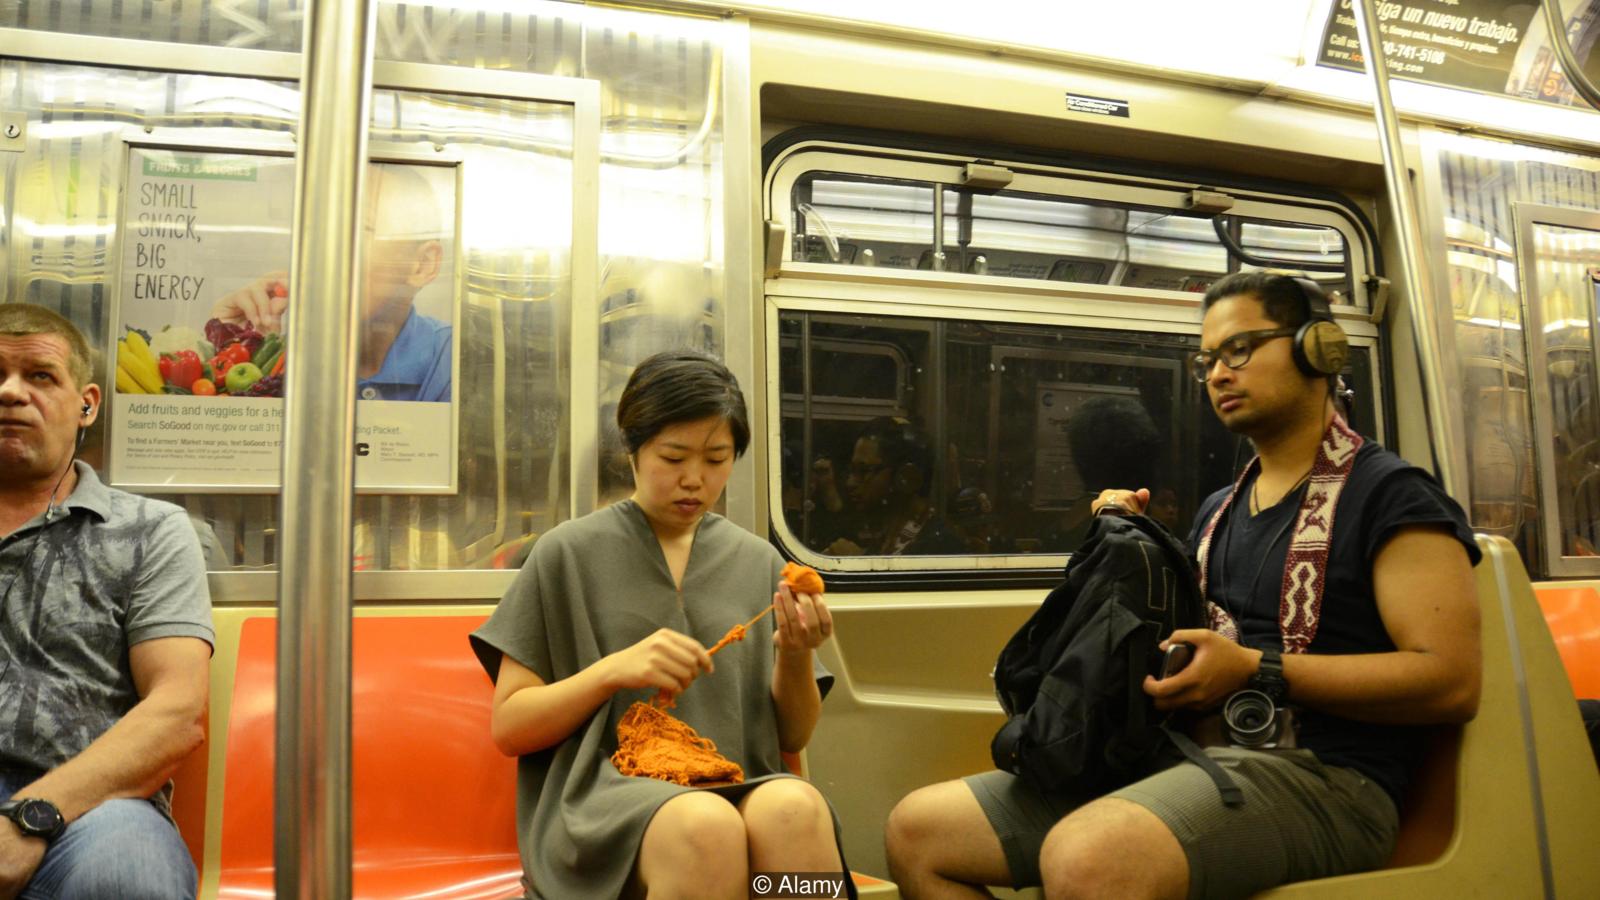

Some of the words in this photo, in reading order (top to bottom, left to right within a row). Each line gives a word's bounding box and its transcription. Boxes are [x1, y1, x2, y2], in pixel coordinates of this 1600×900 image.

[1402, 7, 1424, 23] un
[1423, 11, 1468, 32] nuevo
[1467, 17, 1518, 44] trabajo.
[1330, 34, 1347, 46] Call
[141, 182, 198, 209] SMALL
[138, 212, 201, 242] SNACK,
[136, 243, 166, 269] BIG
[134, 273, 205, 301] ENERGY
[128, 403, 149, 415] Add
[152, 403, 179, 416] fruits
[182, 405, 201, 416] and
[204, 405, 243, 419] veggies
[246, 405, 259, 417] for
[262, 408, 269, 417] a
[128, 420, 157, 430] Search
[159, 420, 191, 430] SoGood
[193, 423, 204, 431] on
